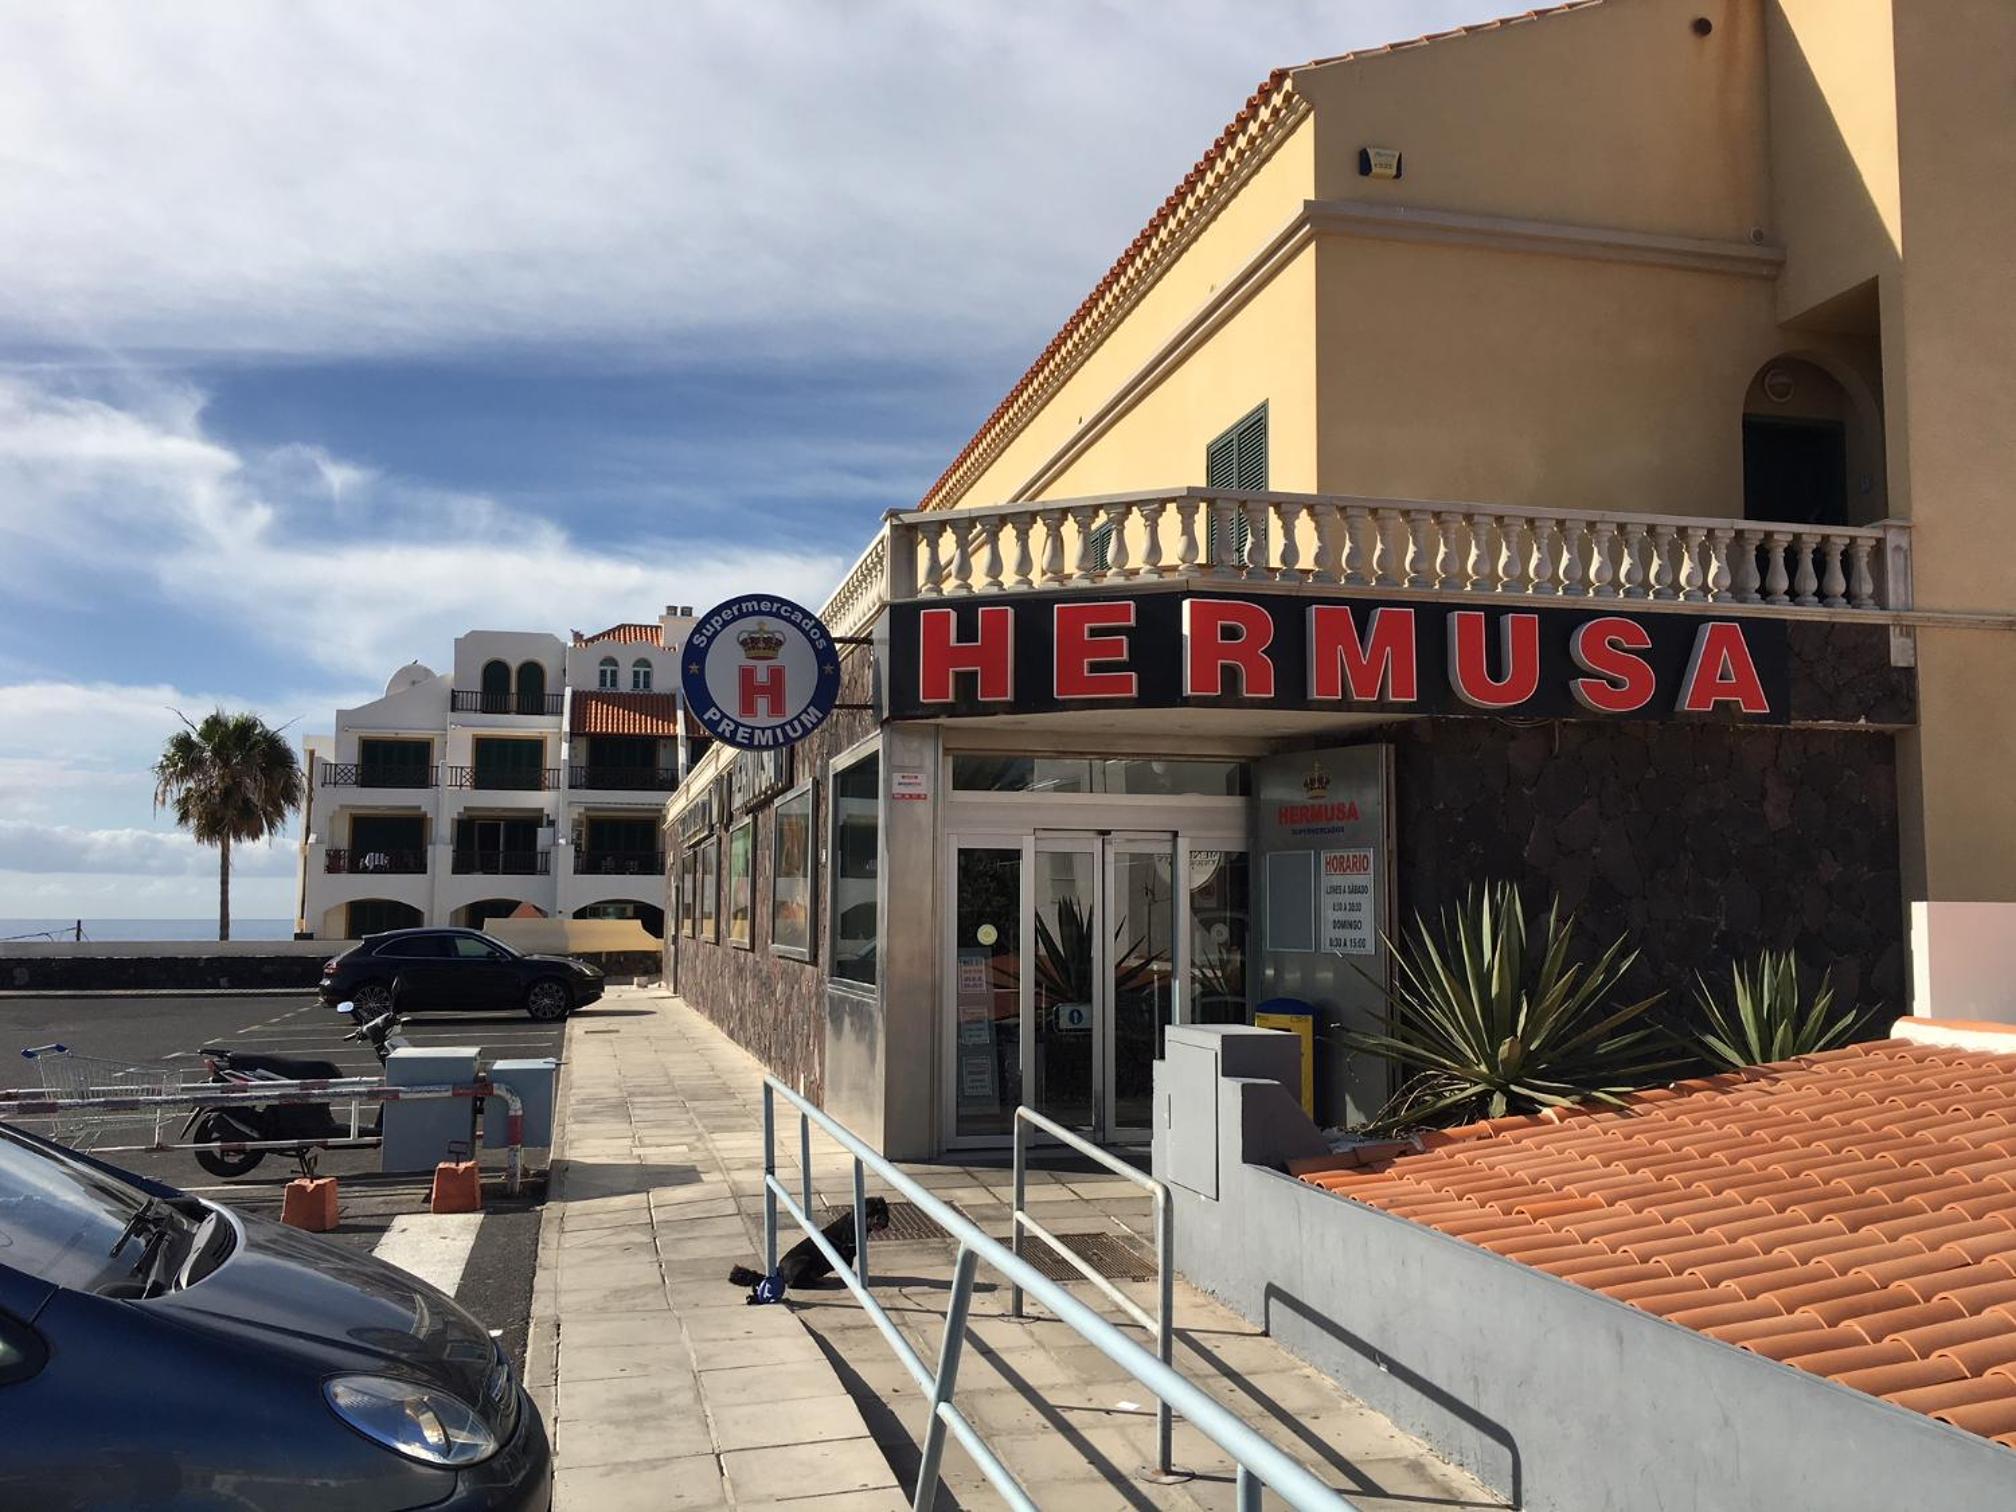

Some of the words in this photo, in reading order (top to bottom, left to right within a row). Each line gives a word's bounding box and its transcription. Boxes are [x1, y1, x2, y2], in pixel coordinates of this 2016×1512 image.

[692, 599, 827, 650] Supermercados
[919, 598, 1771, 717] HERMUSA
[738, 664, 786, 718] H
[702, 704, 824, 747] PREMIUM
[1278, 801, 1360, 825] HERMUSA
[1325, 853, 1369, 873] HORARIO
[1332, 919, 1363, 931] DOMINGO
